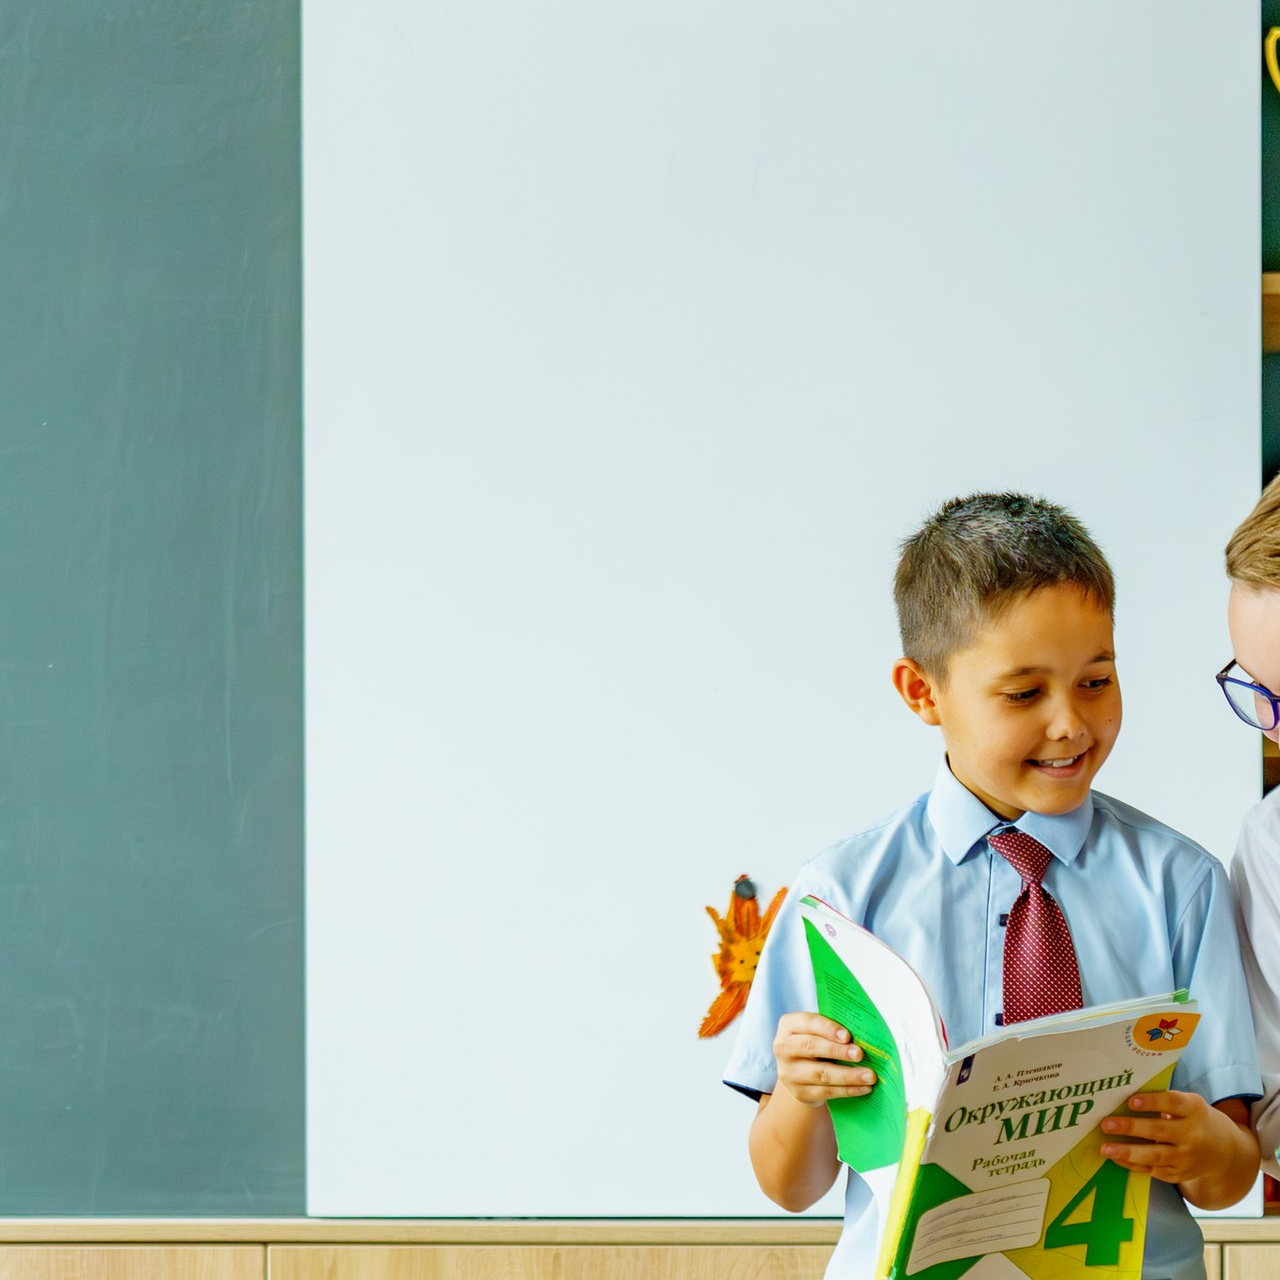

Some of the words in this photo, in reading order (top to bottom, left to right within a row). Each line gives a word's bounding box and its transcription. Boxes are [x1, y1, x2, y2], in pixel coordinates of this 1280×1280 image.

[1132, 1047, 1163, 1057] РОССИИ
[1013, 1072, 1060, 1087] Крючкова
[1016, 1063, 1063, 1077] Плешаков
[944, 1068, 1135, 1133] Окружающий
[993, 1099, 1095, 1146] МИР
[971, 1149, 1036, 1172] Рабочая
[987, 1157, 1046, 1178] тетрадь
[1043, 1158, 1134, 1267] 4
